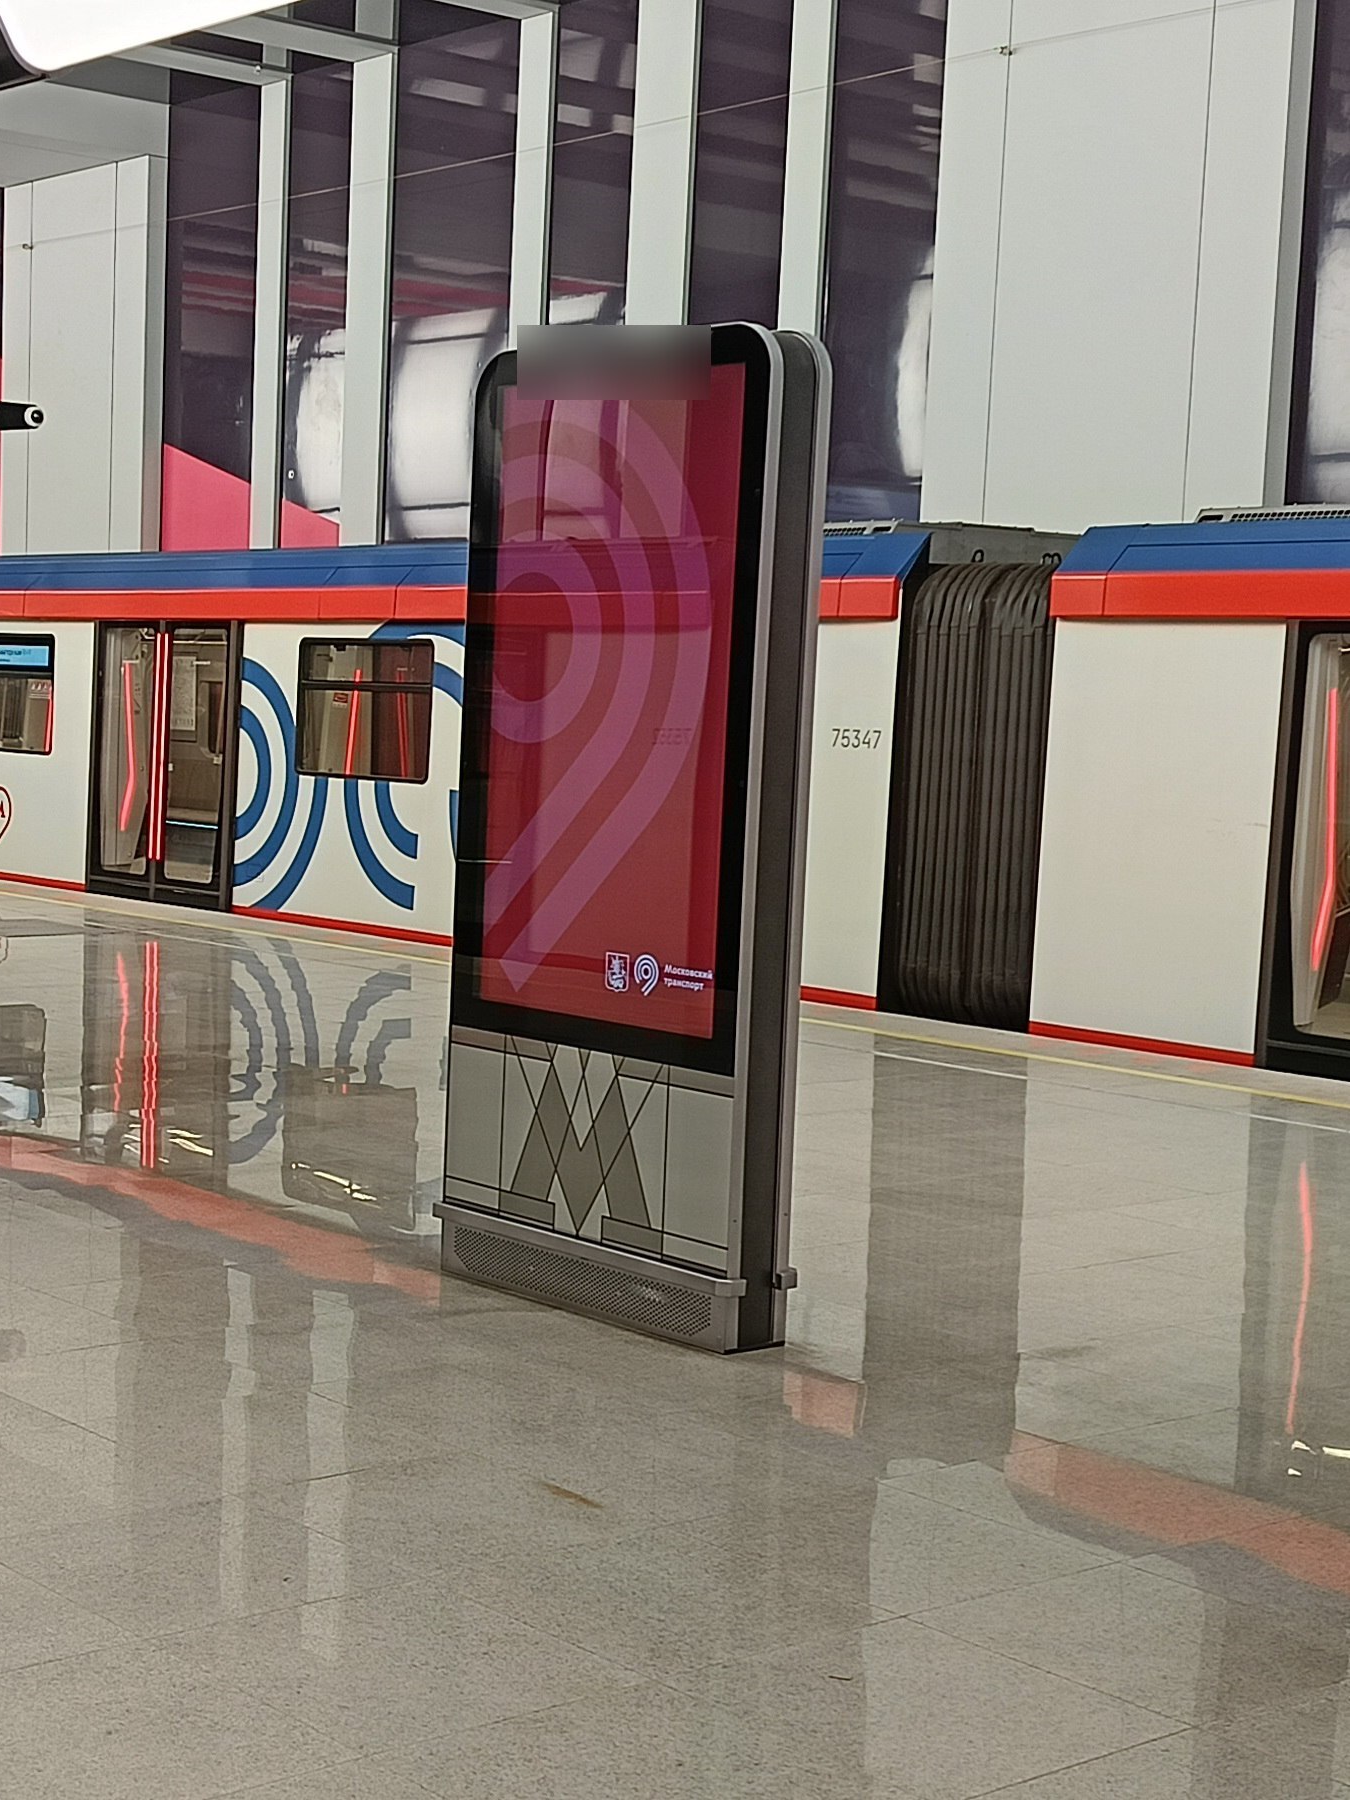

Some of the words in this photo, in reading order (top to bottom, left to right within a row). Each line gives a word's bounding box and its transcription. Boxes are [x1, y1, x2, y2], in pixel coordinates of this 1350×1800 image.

[831, 728, 882, 750] 75347
[663, 963, 713, 980] Московский
[663, 977, 705, 992] транспорт
